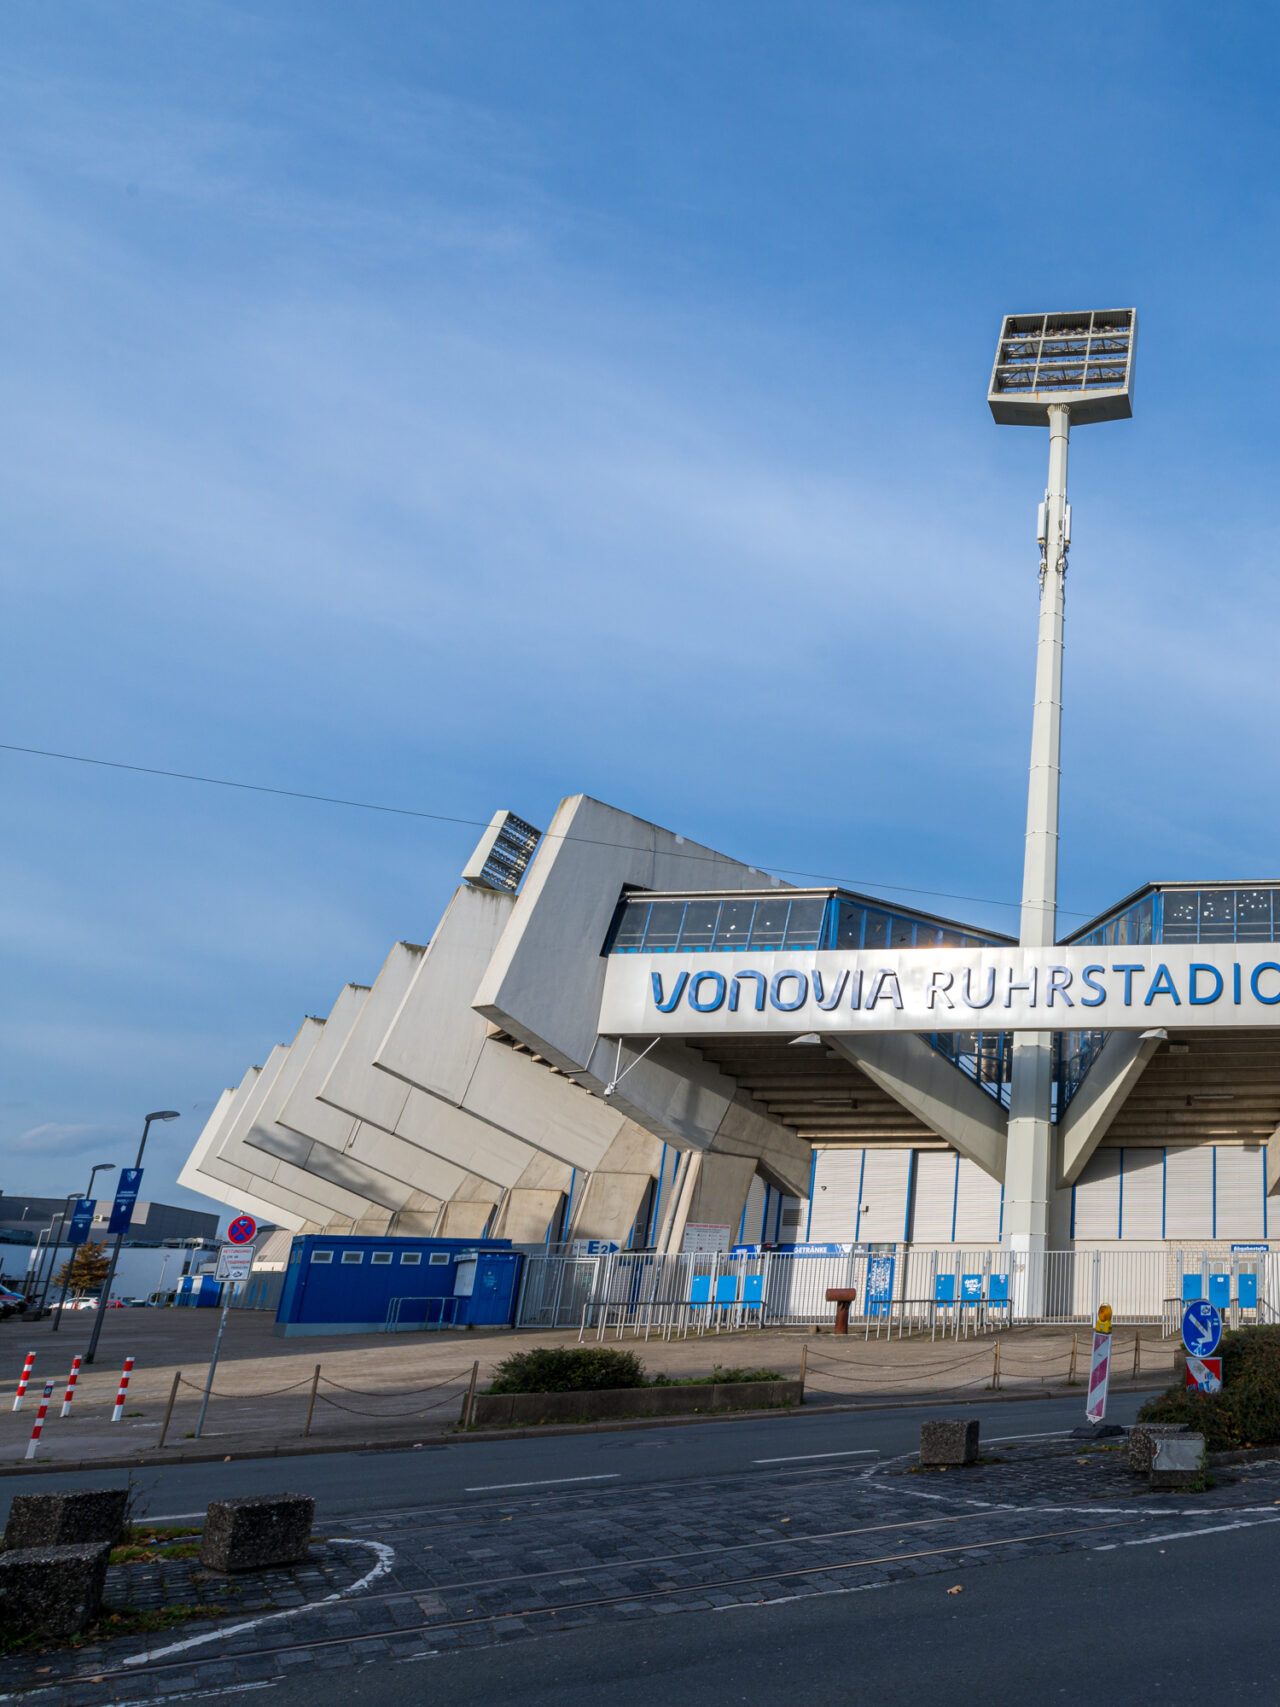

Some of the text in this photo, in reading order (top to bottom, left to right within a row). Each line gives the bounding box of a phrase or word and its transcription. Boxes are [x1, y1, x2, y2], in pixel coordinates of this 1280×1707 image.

[651, 968, 904, 1013] VONOVIA
[587, 1240, 609, 1254] E2
[793, 1245, 828, 1253] GETRÄNKE
